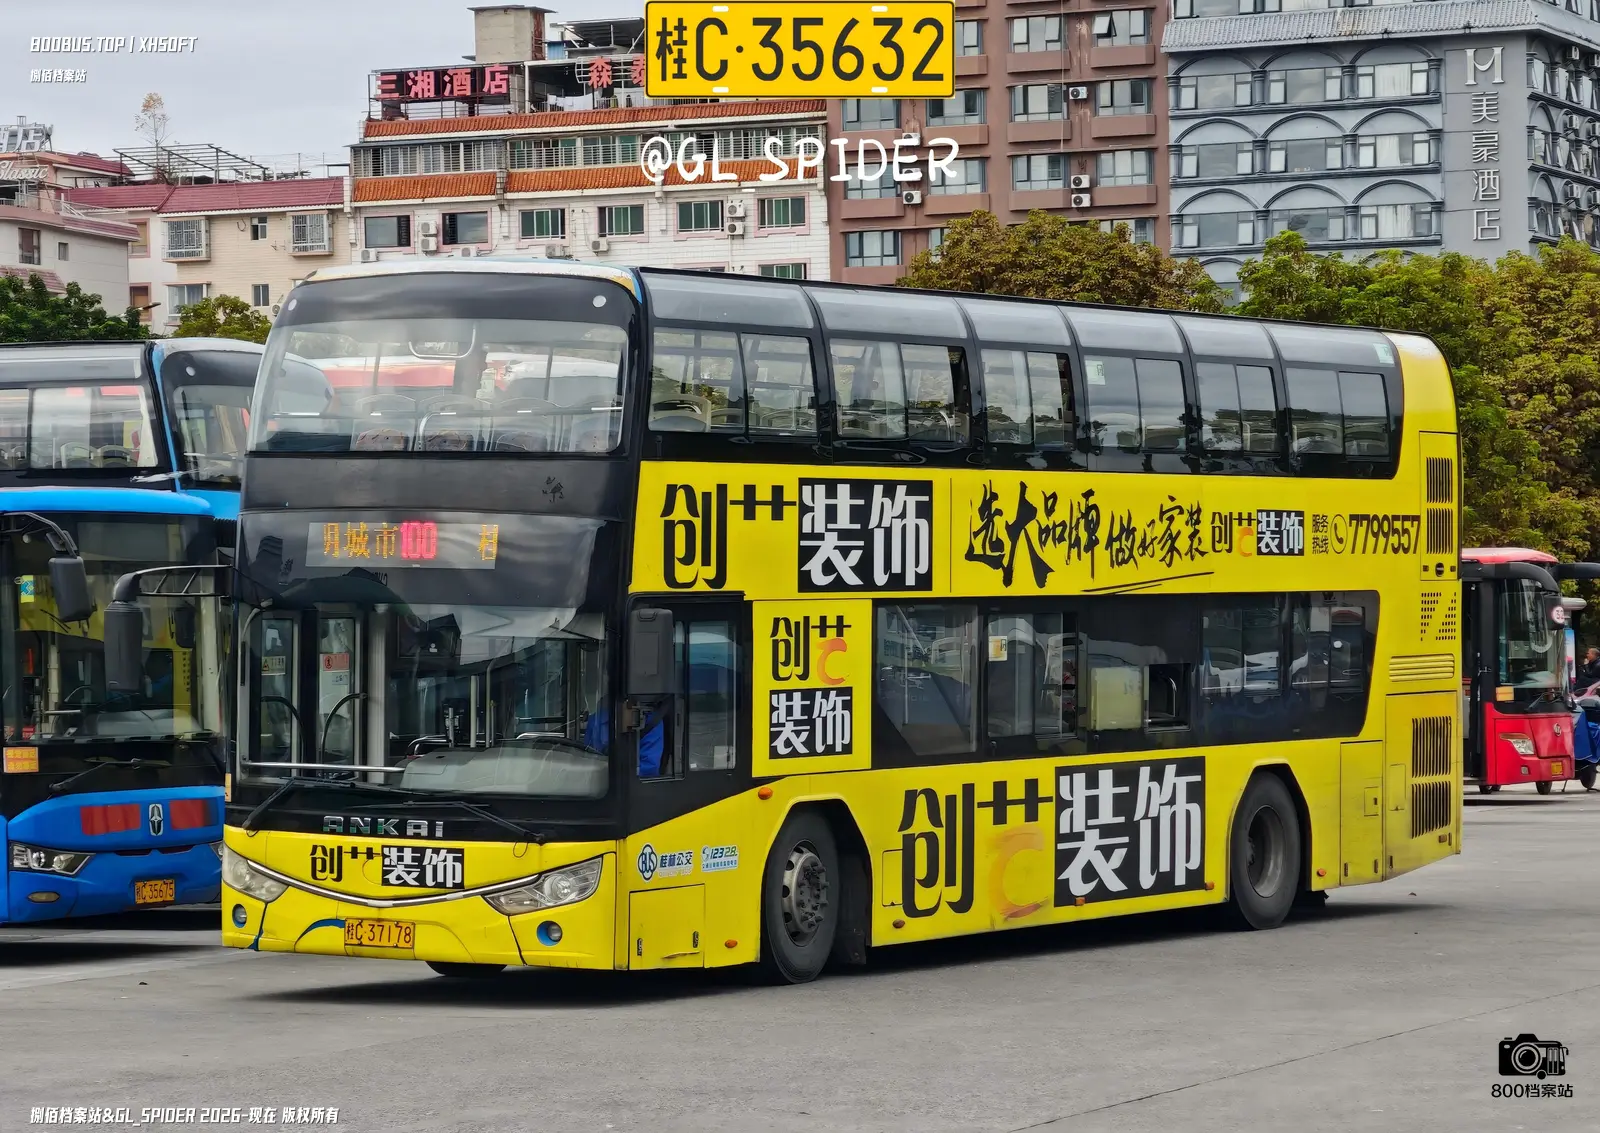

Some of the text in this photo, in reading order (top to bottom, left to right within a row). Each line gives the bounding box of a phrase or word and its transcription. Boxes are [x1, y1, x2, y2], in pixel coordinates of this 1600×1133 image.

[376, 64, 509, 98] 三湘酒店
[1471, 91, 1502, 241] 美豪酒店
[400, 520, 438, 560] 100
[1349, 514, 1421, 555] 7799557
[769, 689, 852, 757] 装饰
[323, 815, 444, 838] ANKAI
[660, 851, 694, 868] 桂林公交
